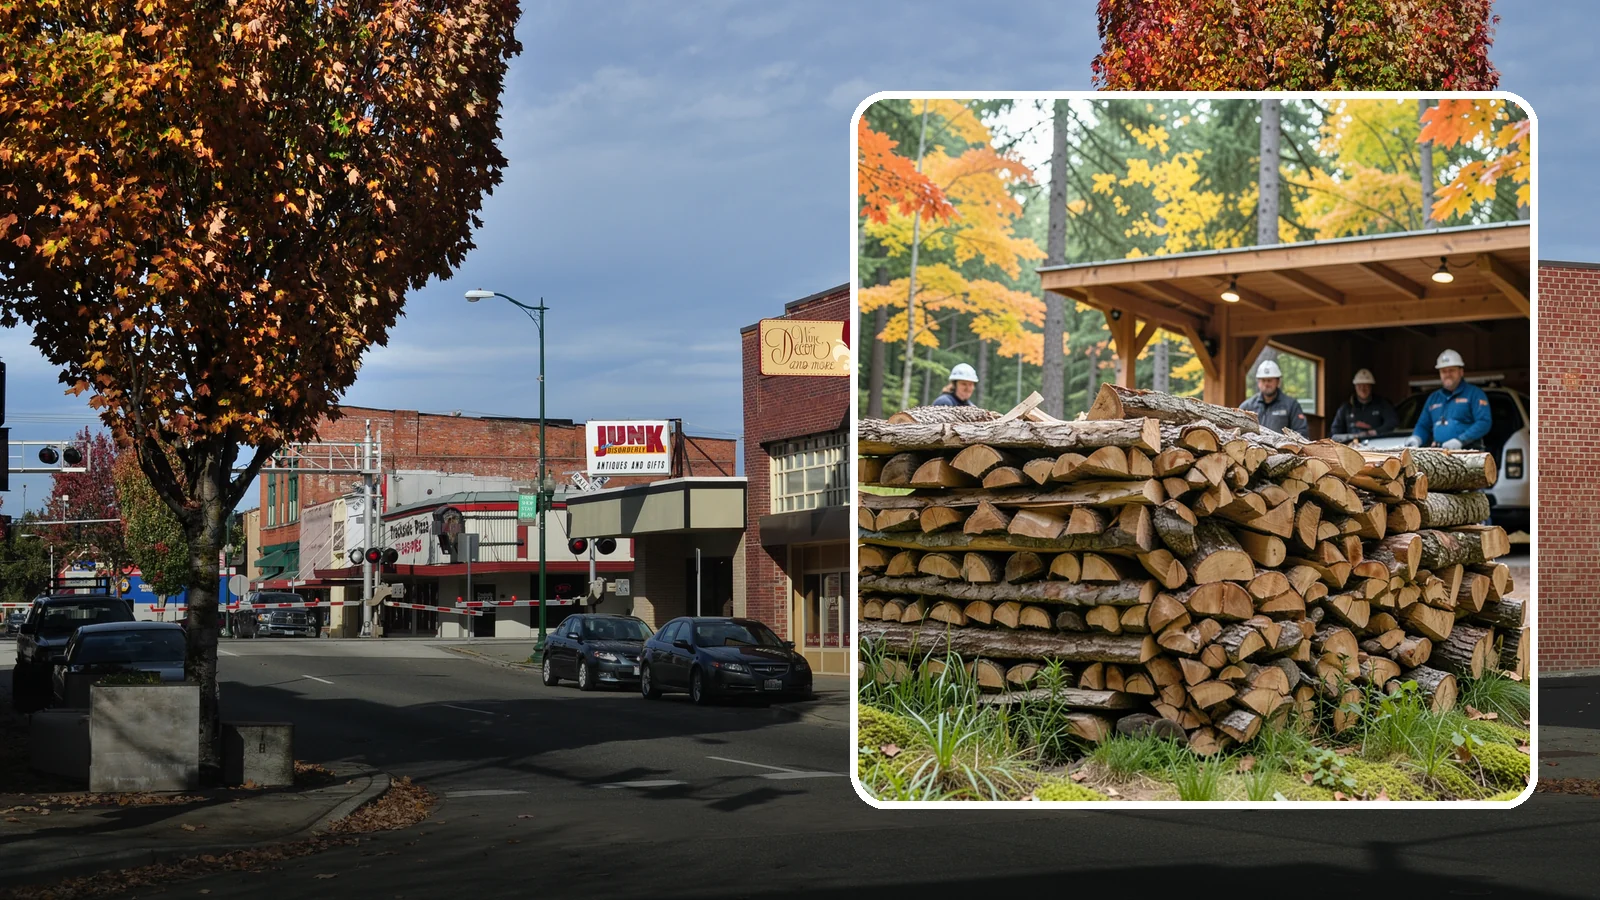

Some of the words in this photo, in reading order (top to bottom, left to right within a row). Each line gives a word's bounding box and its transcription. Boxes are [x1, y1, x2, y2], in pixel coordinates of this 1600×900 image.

[595, 425, 664, 457] JUNK
[607, 446, 646, 454] DISORDERLY
[597, 461, 628, 470] ANTIQUES
[631, 461, 644, 470] AND
[646, 460, 665, 470] GIFTS
[390, 521, 413, 540] Trackside
[414, 519, 429, 535] Pizza
